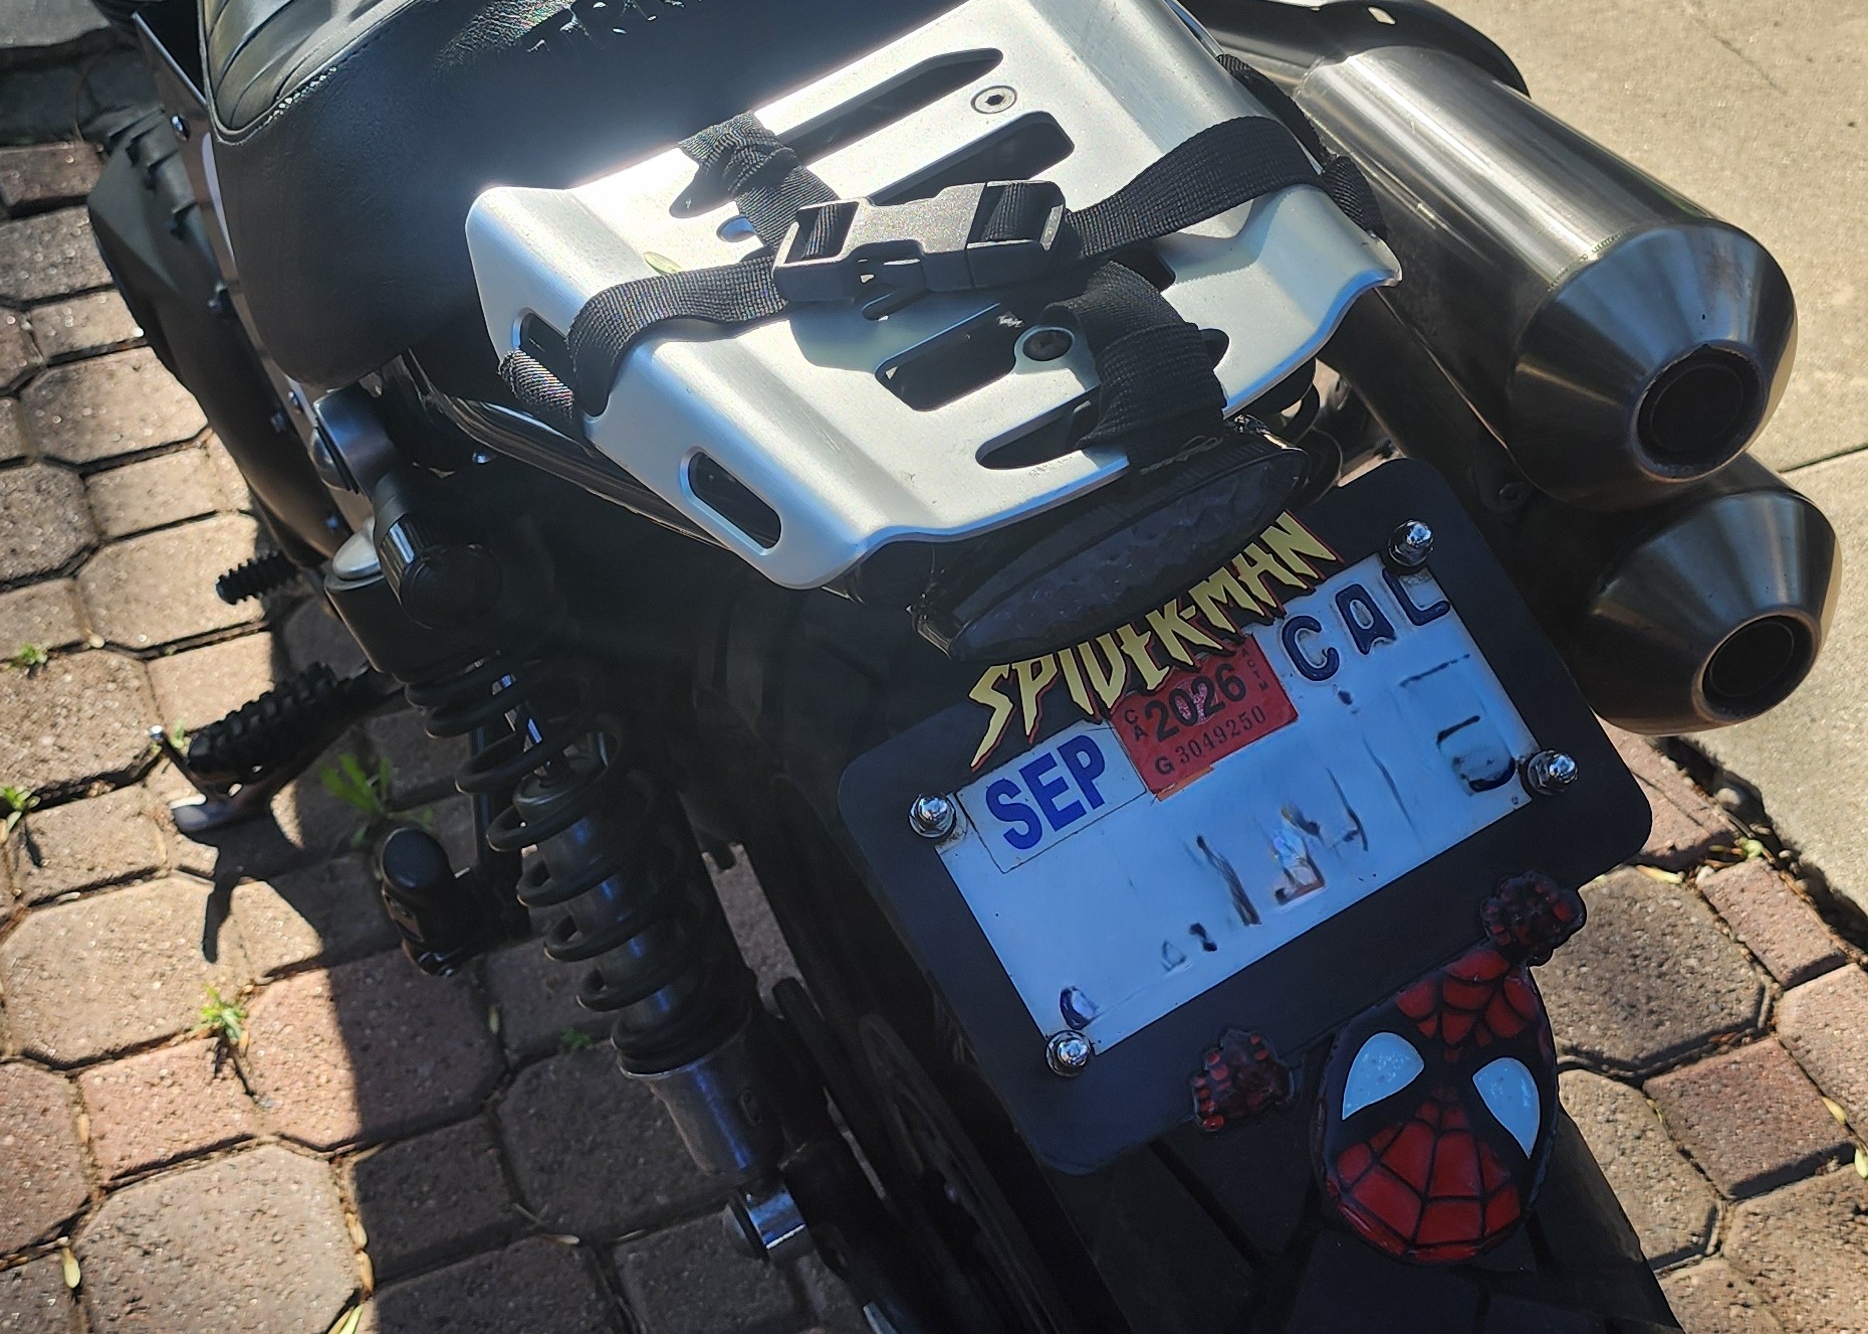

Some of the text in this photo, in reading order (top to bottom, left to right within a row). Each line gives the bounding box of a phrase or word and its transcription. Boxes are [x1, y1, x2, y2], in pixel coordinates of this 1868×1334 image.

[968, 509, 1344, 771] SPIDER-MAN
[1281, 569, 1450, 681] CAL
[1144, 663, 1246, 742] 2026
[985, 734, 1107, 850] SEP
